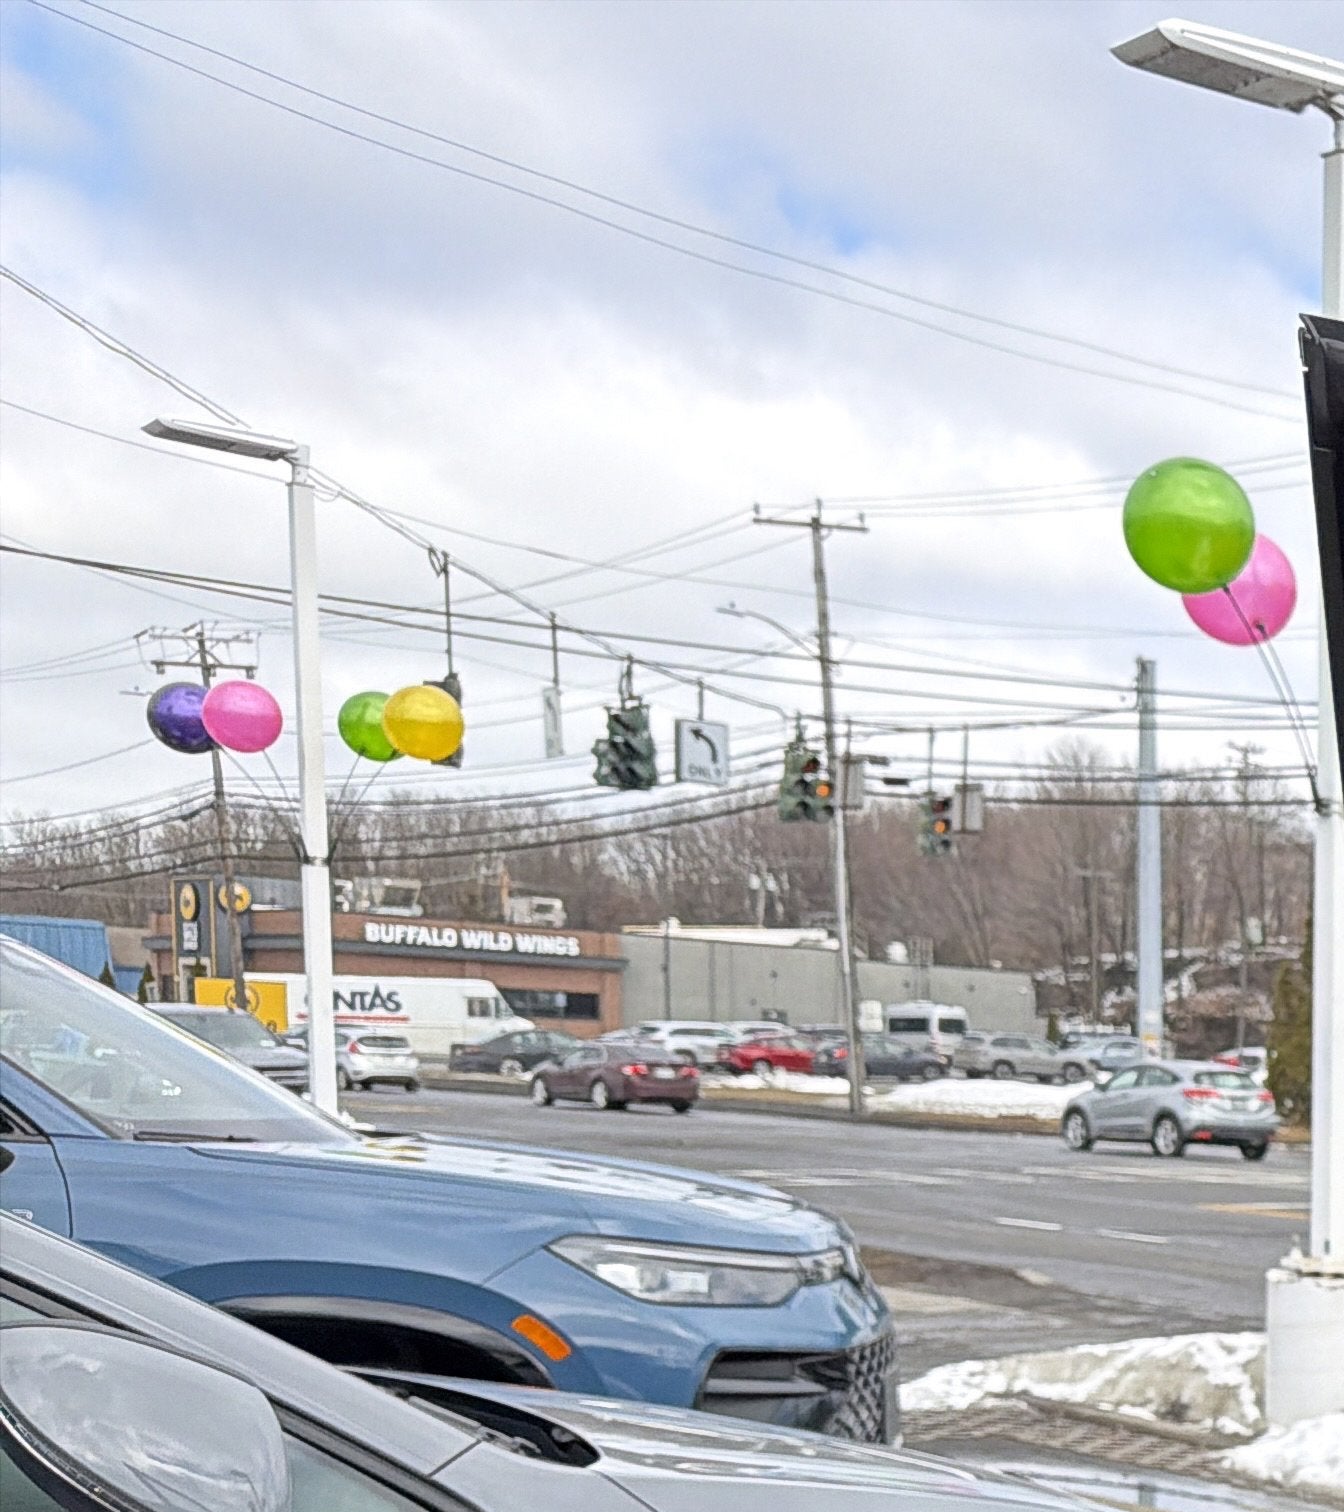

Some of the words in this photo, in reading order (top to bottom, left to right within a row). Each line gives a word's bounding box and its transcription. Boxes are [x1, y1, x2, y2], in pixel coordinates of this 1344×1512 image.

[365, 922, 458, 948] BUFFALO
[461, 928, 514, 951] WILD
[515, 932, 580, 957] WINGS
[303, 982, 402, 1012] NTAS
